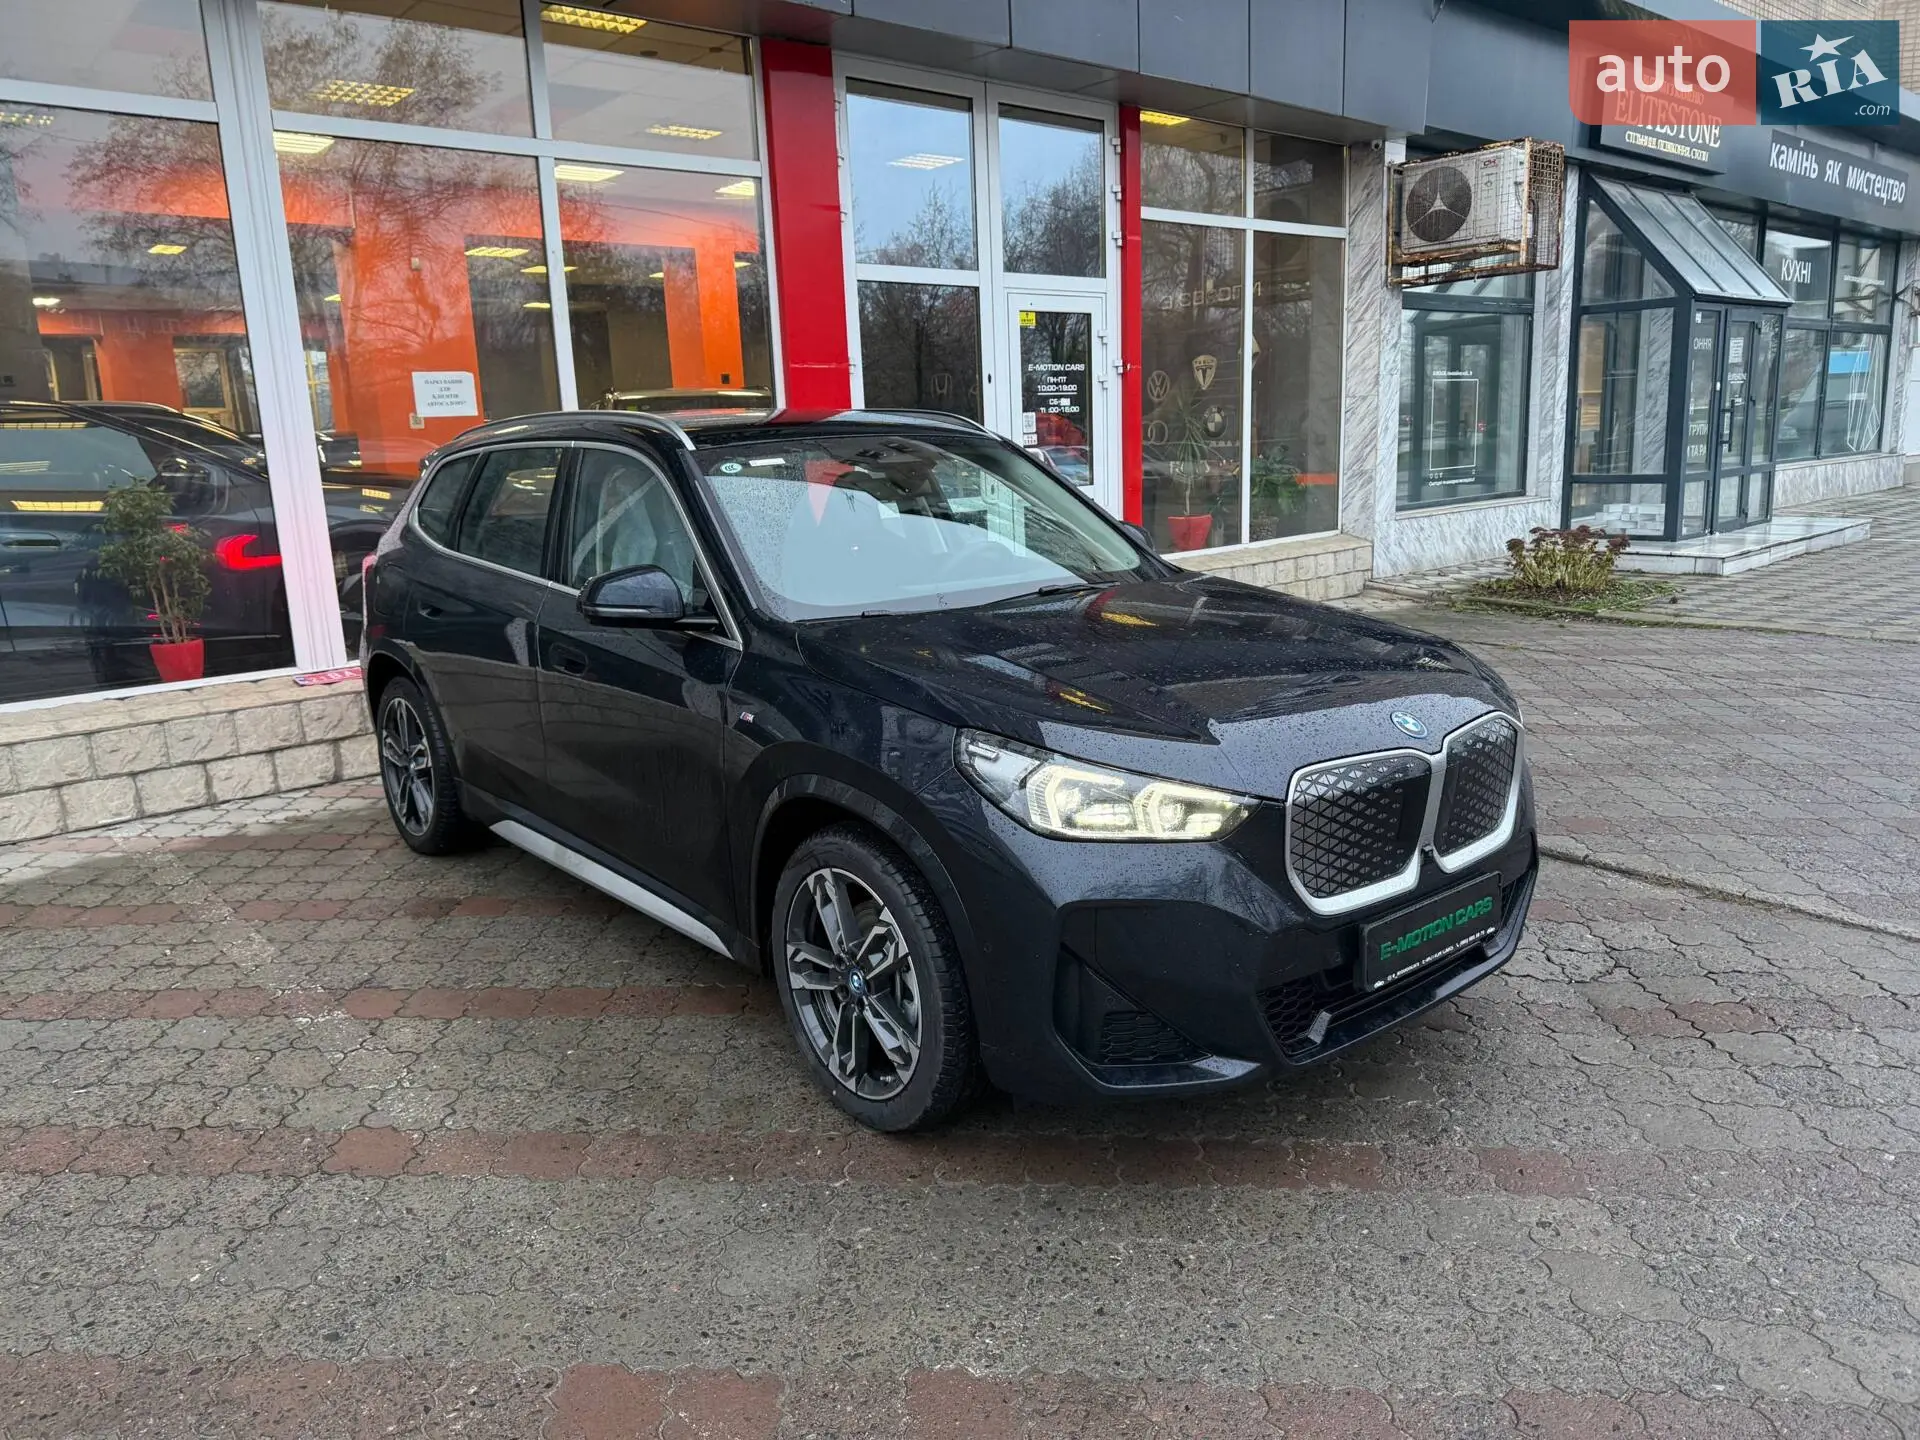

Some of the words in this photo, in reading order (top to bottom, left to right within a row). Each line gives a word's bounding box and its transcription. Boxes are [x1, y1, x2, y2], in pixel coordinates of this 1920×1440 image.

[1614, 89, 1722, 148] ELITESTONE
[1769, 140, 1819, 179] камінь
[1824, 159, 1842, 185] як
[1846, 165, 1906, 205] мистецтво
[1781, 258, 1811, 284] КУХНІ
[1028, 363, 1064, 371] E-MOTION
[1065, 363, 1085, 371] CARS
[1380, 913, 1453, 961] E-MOTION
[1455, 896, 1493, 926] CARS
